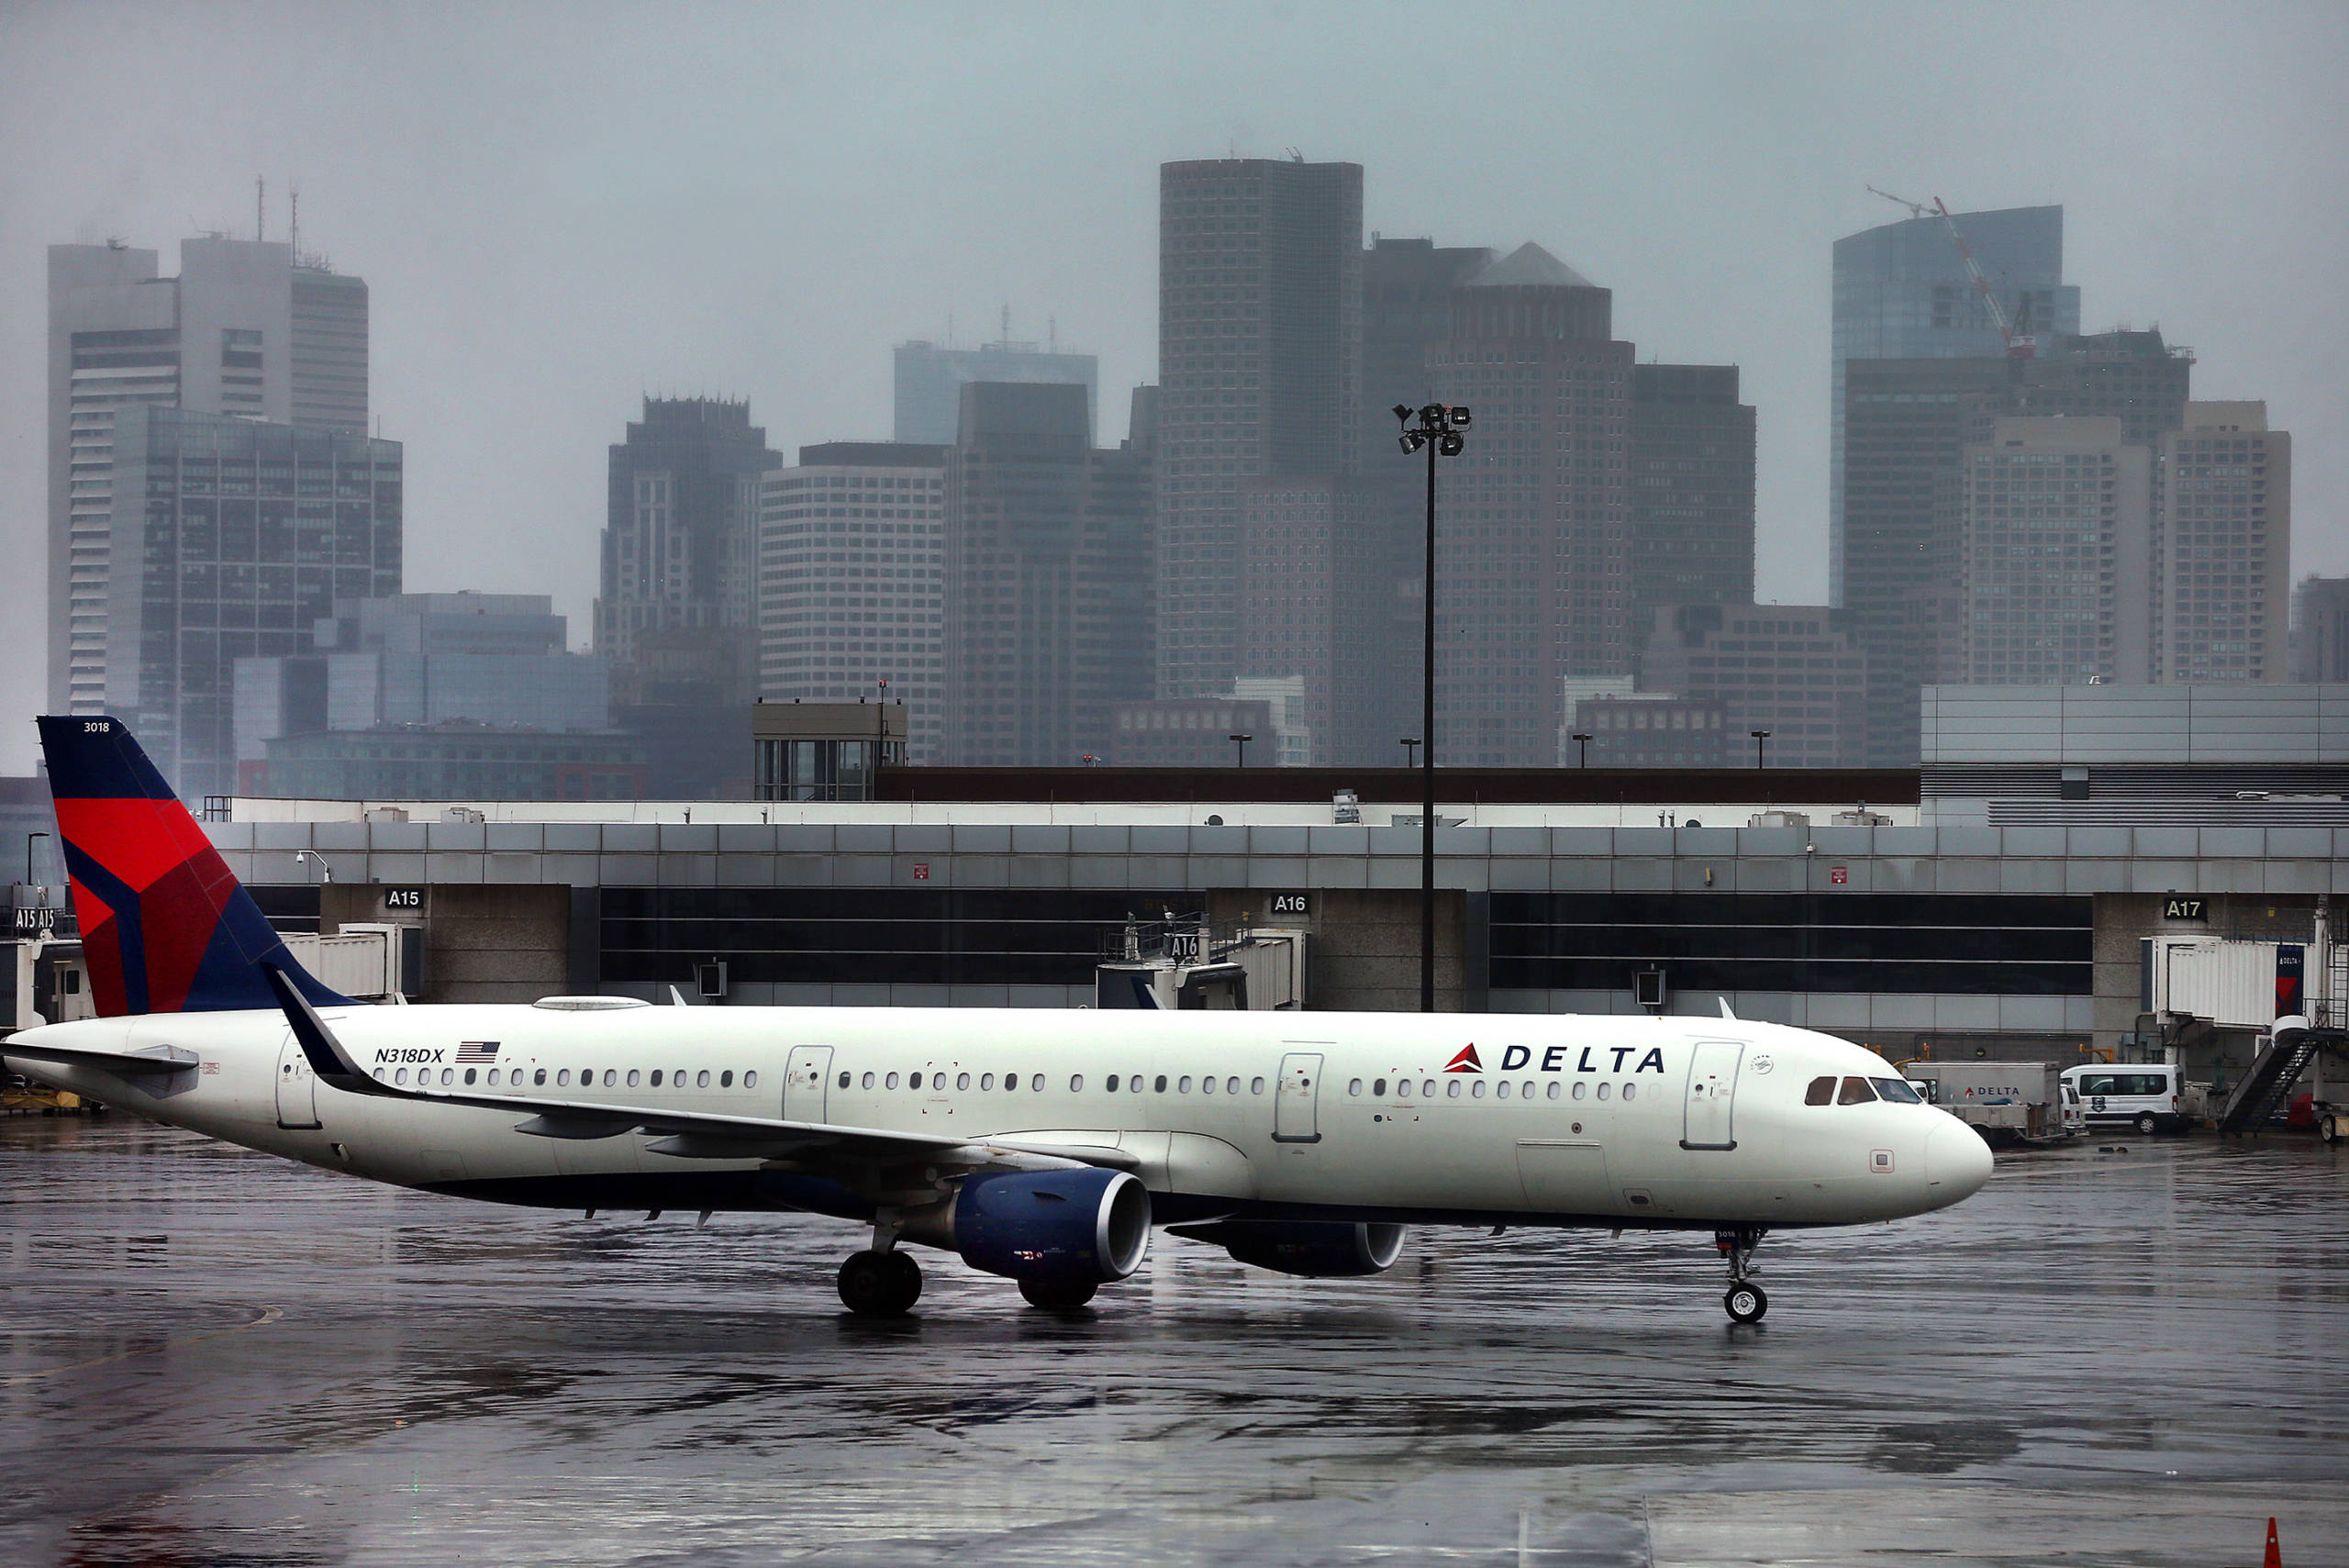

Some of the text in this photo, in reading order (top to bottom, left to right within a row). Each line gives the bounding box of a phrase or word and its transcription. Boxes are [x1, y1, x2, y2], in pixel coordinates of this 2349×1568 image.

[83, 721, 110, 733] 3018
[388, 890, 419, 906] A15
[1275, 895, 1306, 911] A16
[2166, 900, 2201, 917] A17
[16, 909, 36, 929] A15
[38, 909, 54, 929] A15
[1172, 937, 1197, 956] A16
[374, 1049, 445, 1063] N318DX
[1500, 1045, 1664, 1073] DELTA
[1978, 1086, 2020, 1095] DELTA
